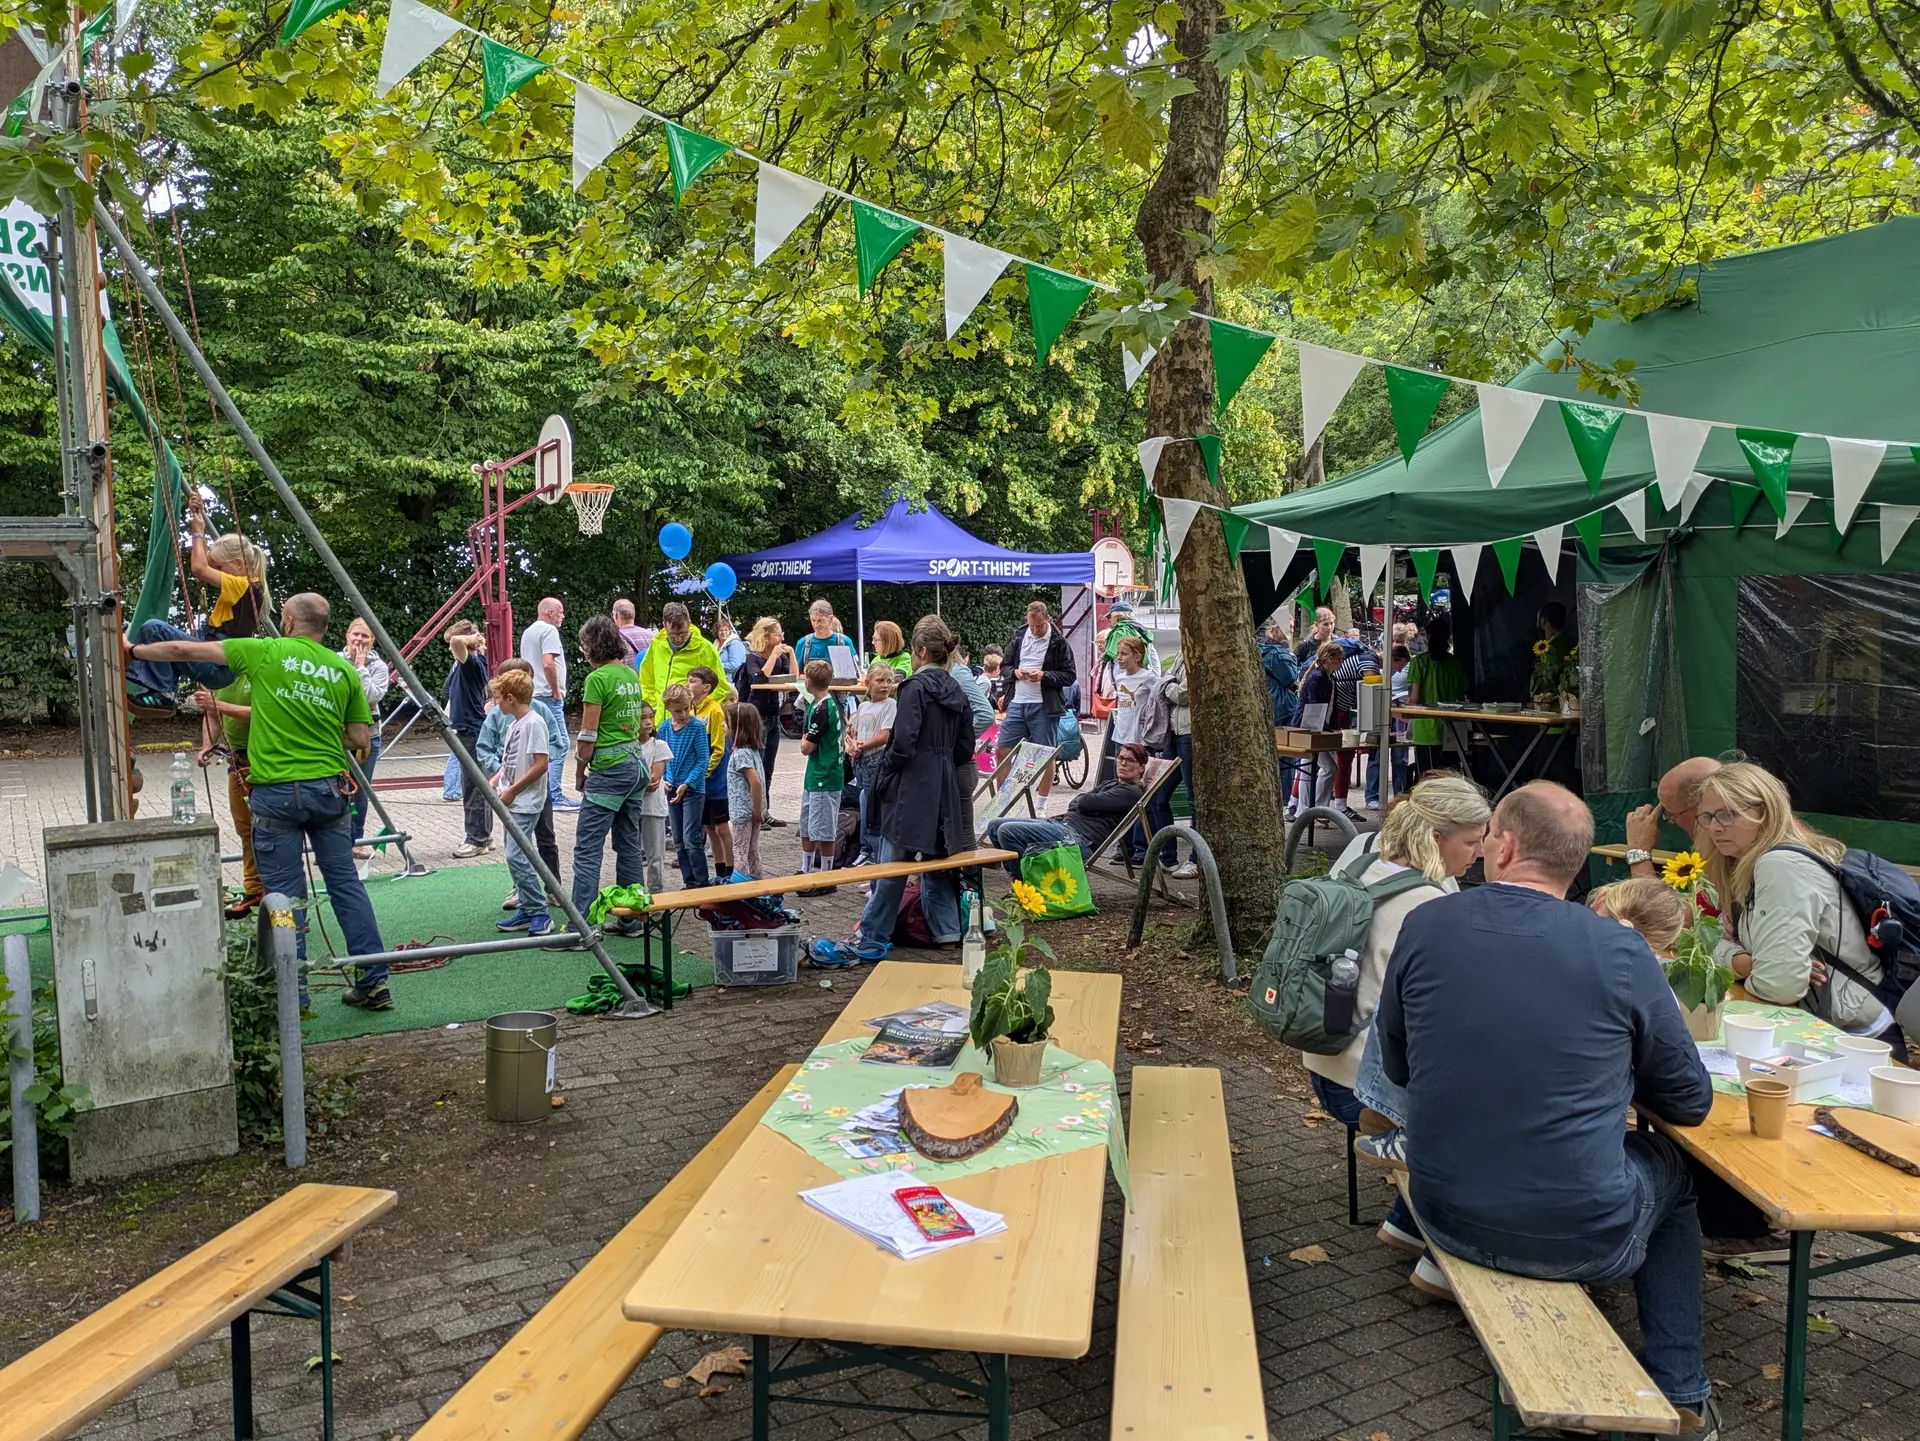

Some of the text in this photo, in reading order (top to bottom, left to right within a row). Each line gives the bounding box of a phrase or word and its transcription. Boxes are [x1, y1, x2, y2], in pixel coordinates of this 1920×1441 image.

[928, 558, 1032, 577] SPORT-THIEME
[301, 659, 343, 684] DAV
[276, 687, 335, 710] KLETTERN
[293, 680, 325, 697] TEAM
